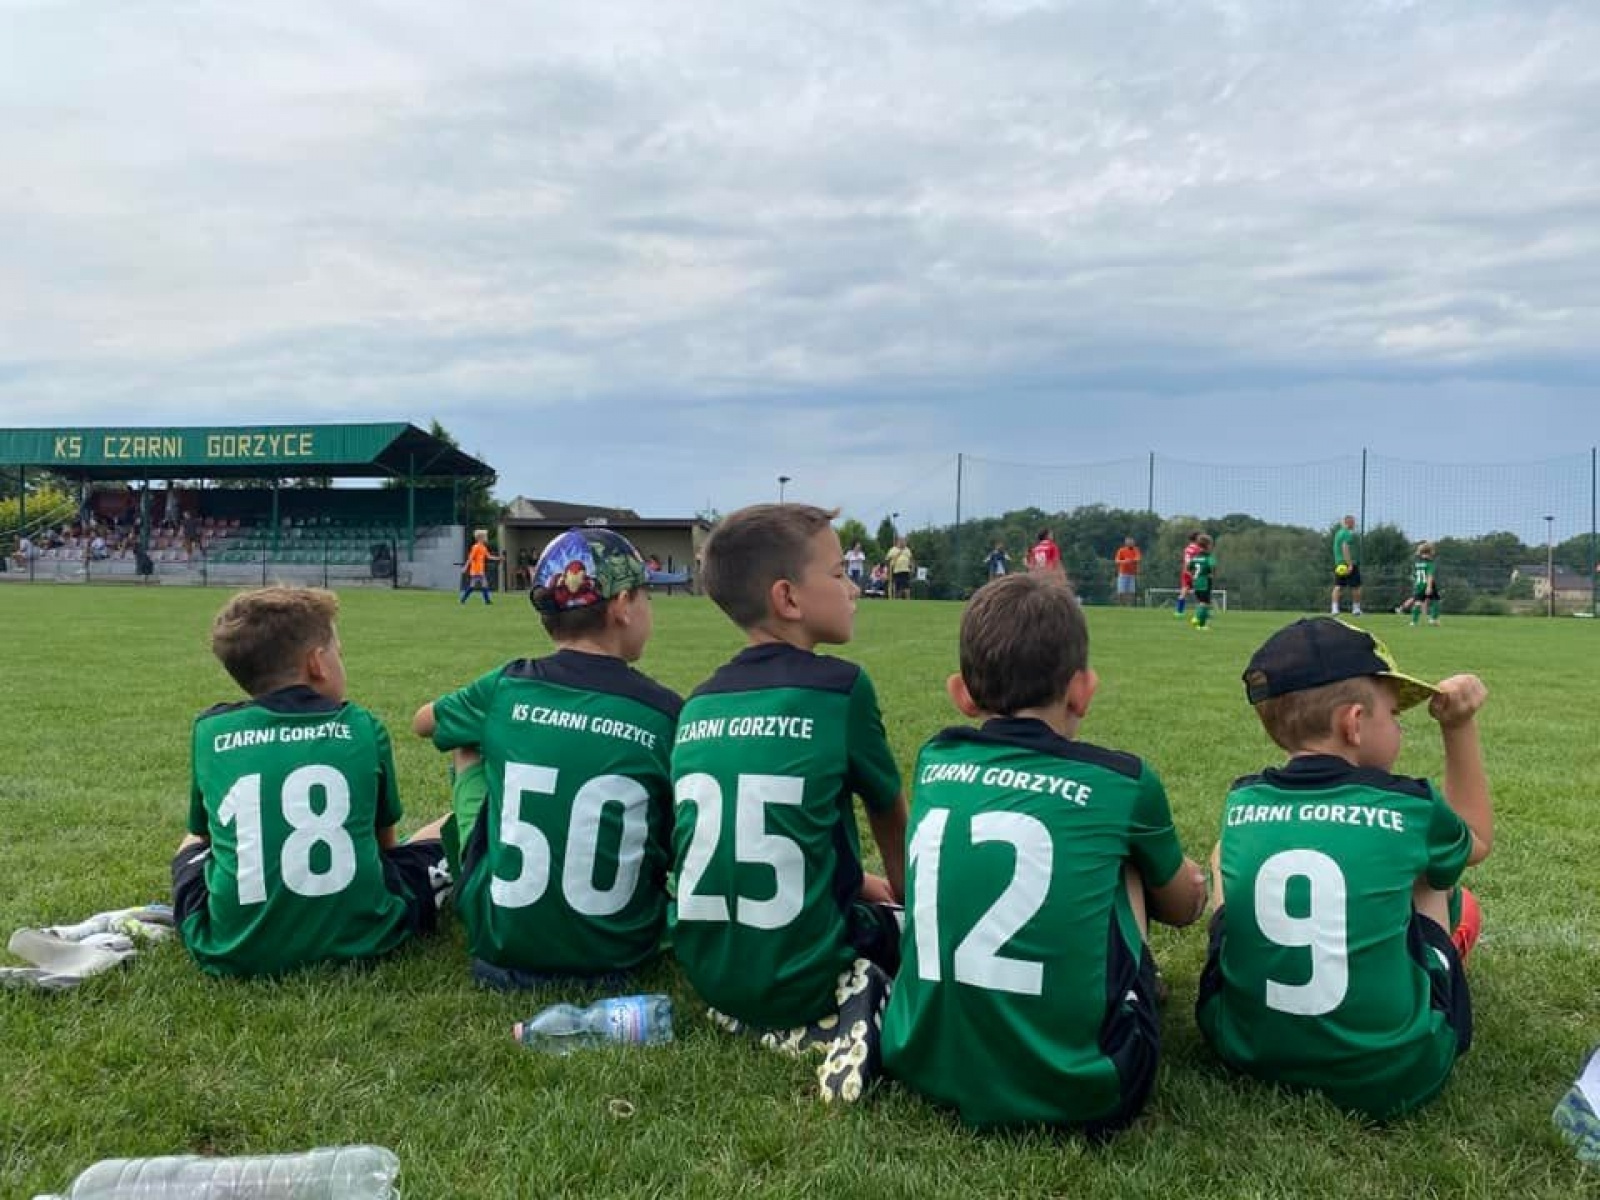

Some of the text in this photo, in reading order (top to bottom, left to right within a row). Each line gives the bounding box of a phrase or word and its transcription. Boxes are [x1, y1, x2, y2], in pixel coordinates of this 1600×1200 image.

[54, 433, 313, 459] KS CZARNI GORZYCE
[214, 721, 352, 752] CZARNI GORZYCE
[511, 702, 656, 749] KS CZARNI GORZYCE
[676, 715, 814, 744] CZARNI GORZYCE
[921, 763, 1092, 806] CZARNI GORZYCE
[217, 764, 356, 906] 18
[490, 761, 649, 916] 50
[1227, 804, 1405, 833] CZARNI GORZYCE
[673, 772, 805, 930] 25
[908, 807, 1054, 996] 12
[1254, 849, 1349, 1016] 9
